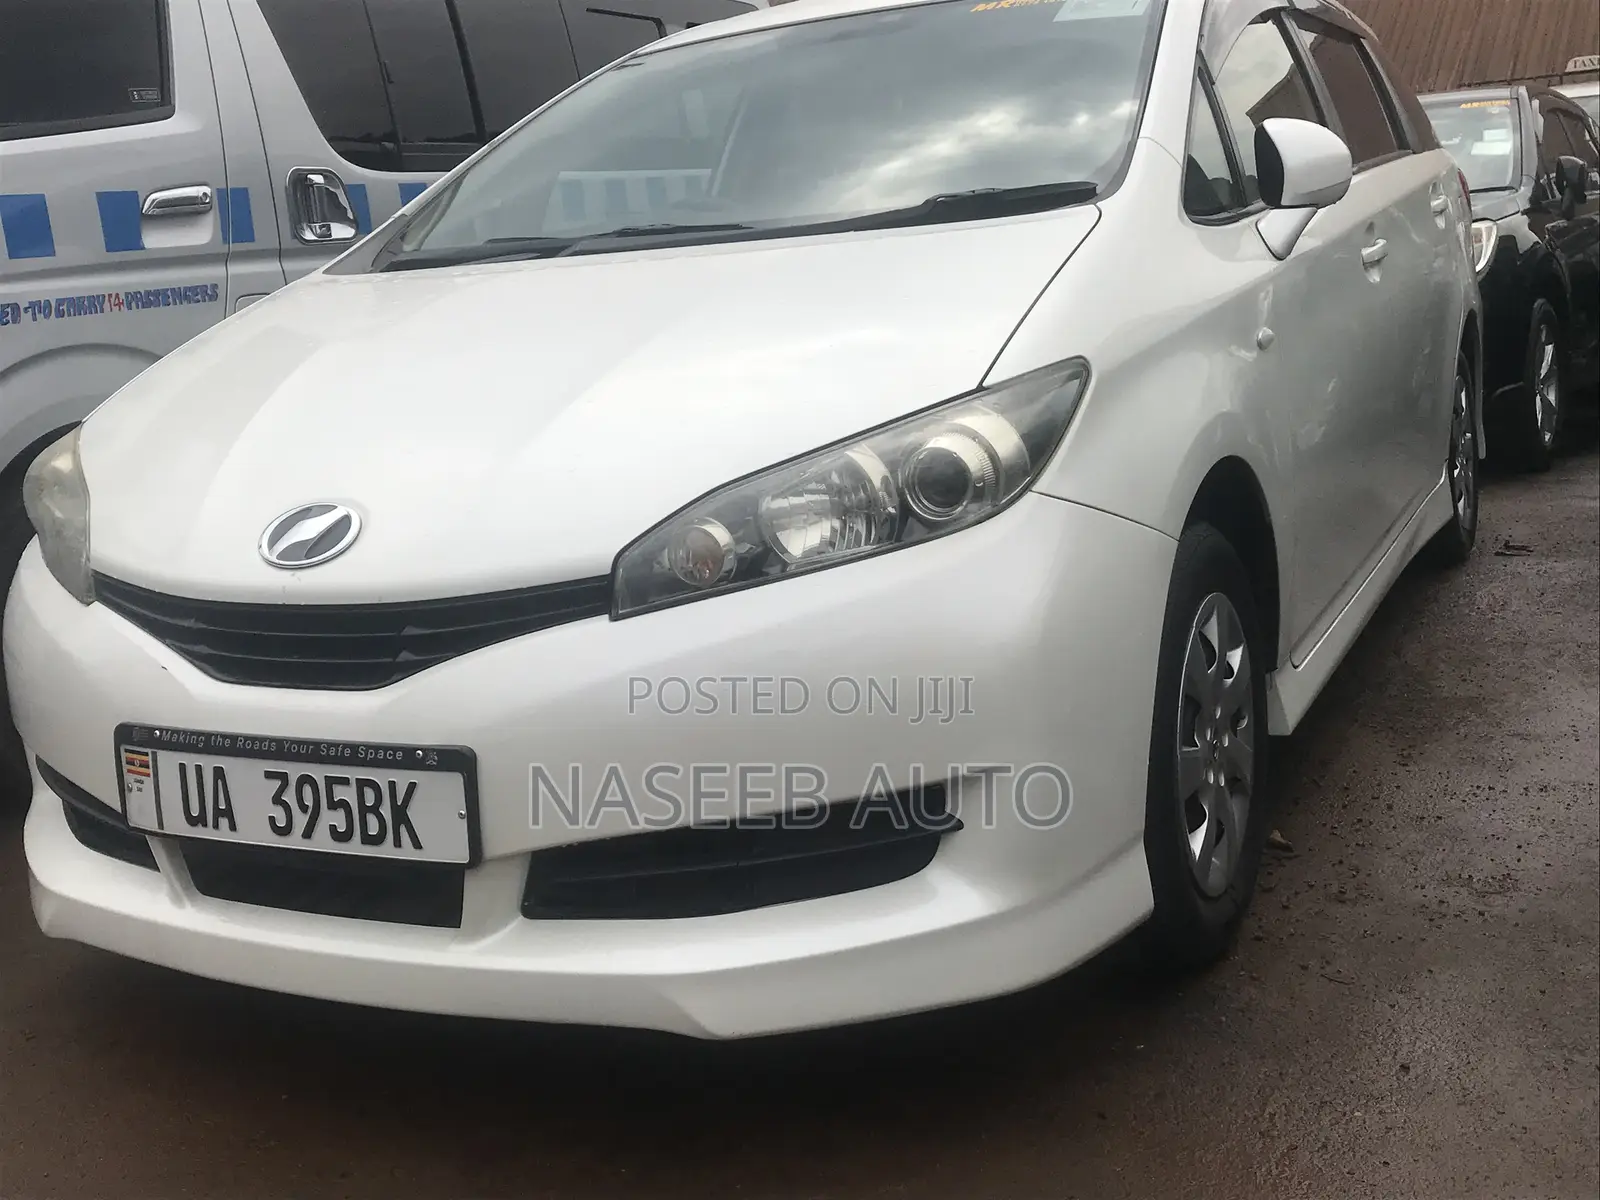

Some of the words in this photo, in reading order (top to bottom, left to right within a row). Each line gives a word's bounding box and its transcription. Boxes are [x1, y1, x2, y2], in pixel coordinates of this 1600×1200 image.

[54, 294, 105, 319] CARRY
[107, 292, 124, 313] 14
[124, 283, 219, 311] PASSENGERS
[161, 730, 205, 747] Making
[211, 735, 231, 747] the
[236, 737, 276, 751] Roads
[283, 741, 314, 754] Your
[320, 743, 351, 757] Safe
[358, 746, 403, 760] Space
[178, 762, 237, 831] UA
[264, 769, 423, 849] 395BK
